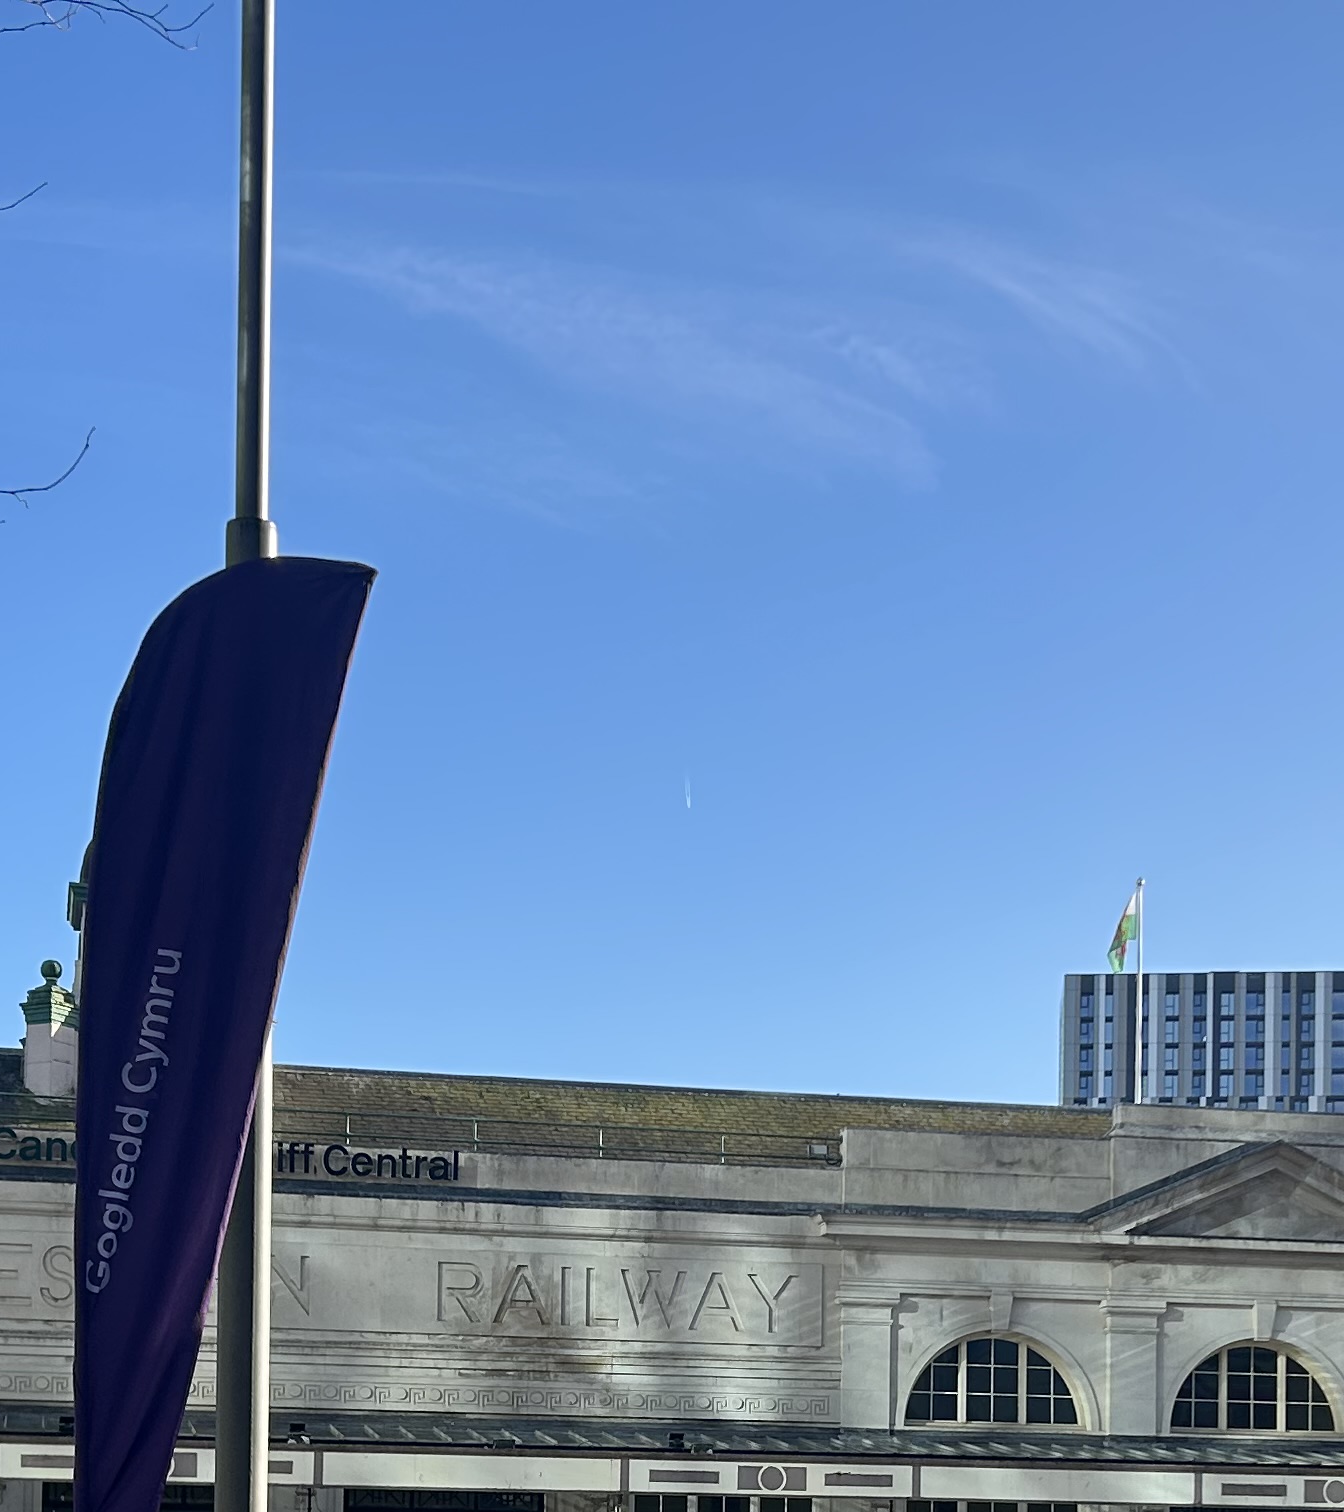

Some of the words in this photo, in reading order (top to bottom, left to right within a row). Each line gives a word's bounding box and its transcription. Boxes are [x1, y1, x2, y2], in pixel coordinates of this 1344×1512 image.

[85, 1105, 150, 1294] Gogledd
[121, 948, 183, 1094] Cymru
[323, 1144, 459, 1181] Central
[436, 1260, 800, 1334] RAILWAY
